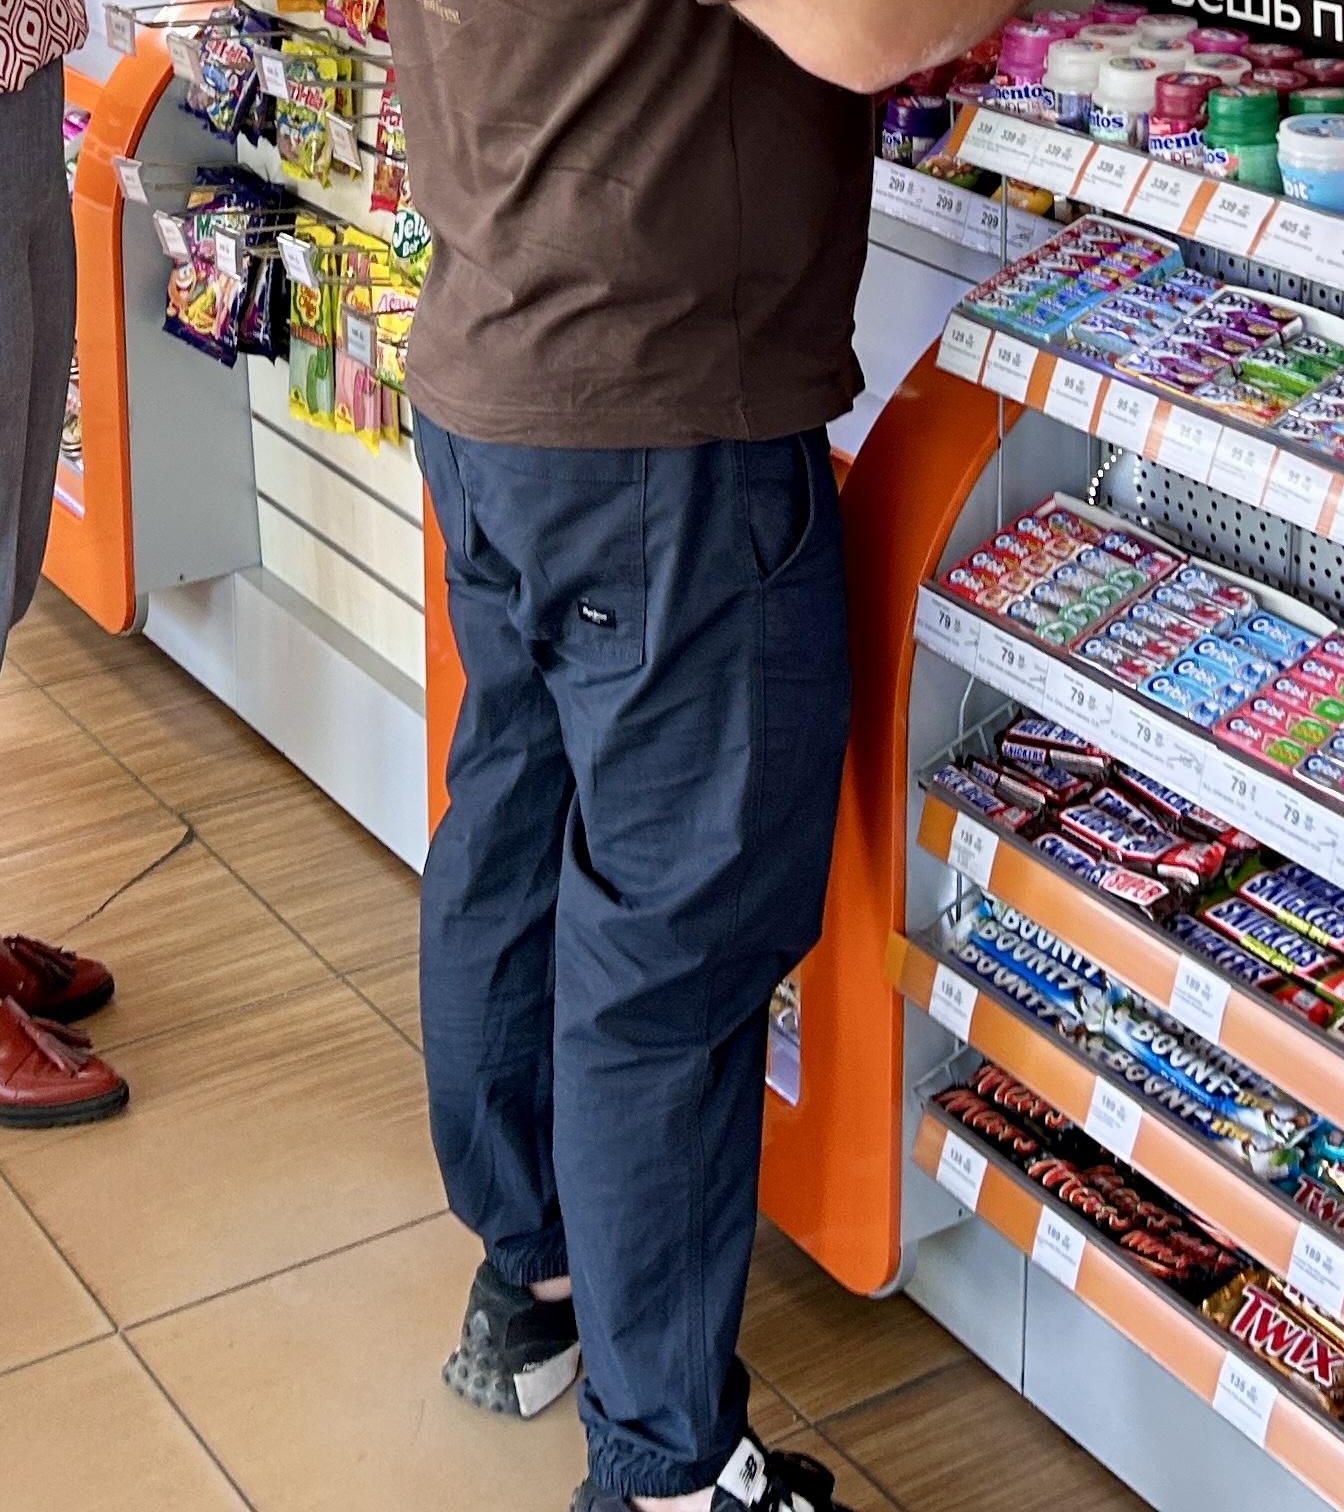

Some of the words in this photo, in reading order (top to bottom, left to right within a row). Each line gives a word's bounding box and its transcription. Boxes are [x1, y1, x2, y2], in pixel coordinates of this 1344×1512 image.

[937, 611, 952, 628] 79
[1000, 645, 1015, 666] 79
[1070, 686, 1085, 706] 79
[1136, 722, 1153, 743] 79
[1231, 775, 1247, 797] 79
[1283, 802, 1301, 824] 79
[980, 920, 1087, 992] BOUNTY
